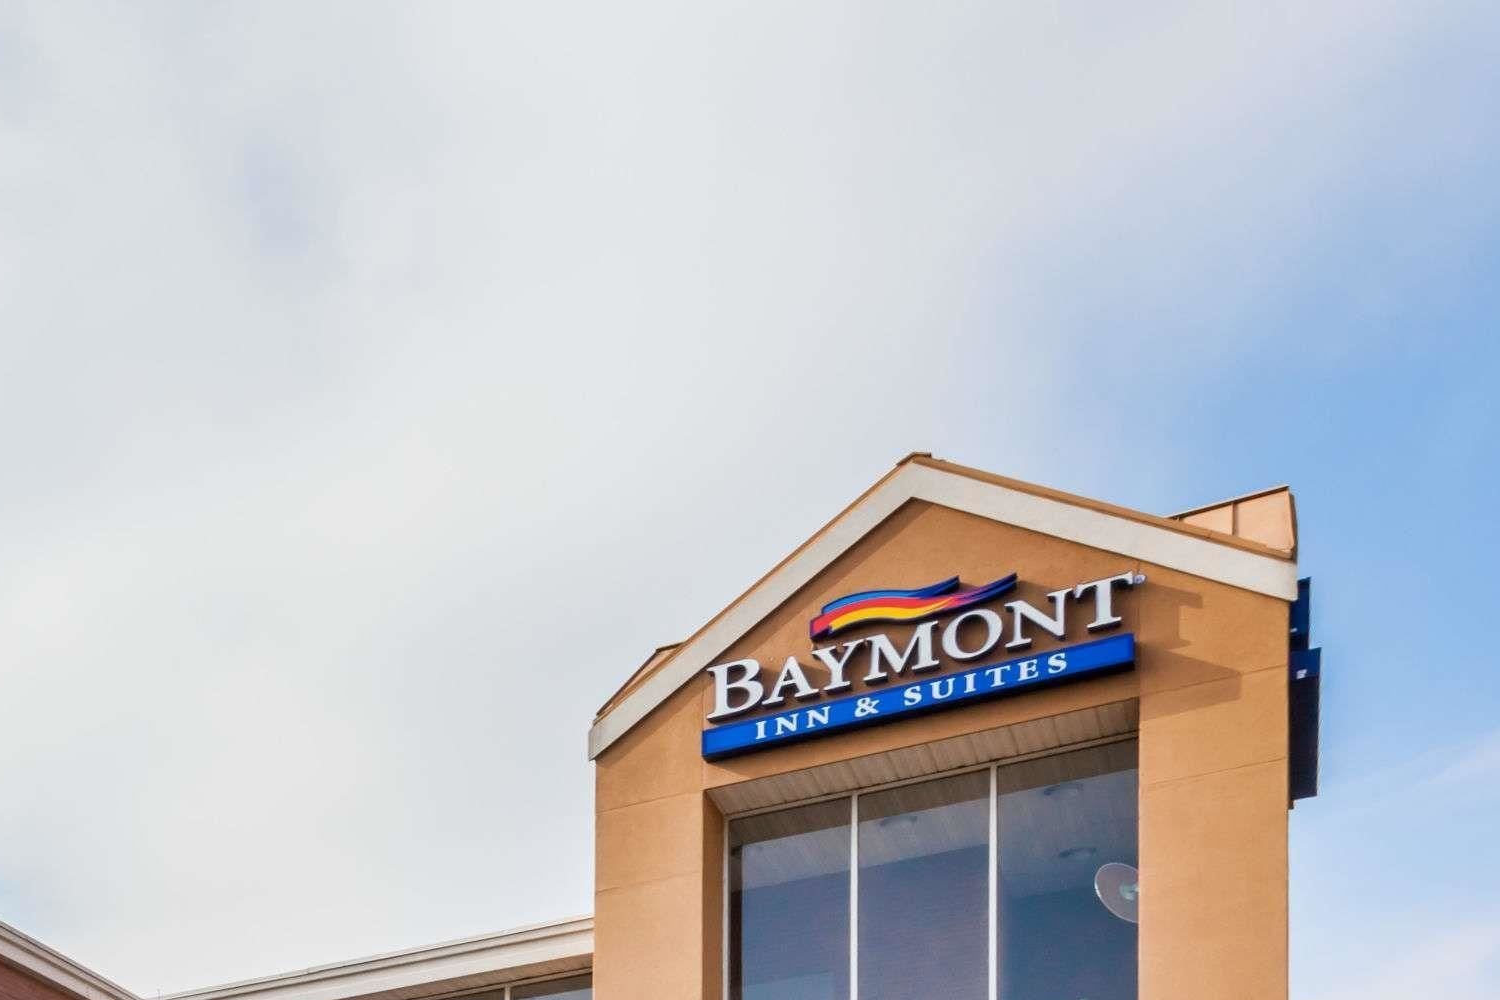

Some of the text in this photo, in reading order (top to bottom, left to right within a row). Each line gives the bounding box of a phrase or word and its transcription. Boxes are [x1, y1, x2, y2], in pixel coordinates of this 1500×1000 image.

[706, 571, 1134, 720] BAYMONT
[755, 652, 1069, 740] INN & SUITES
